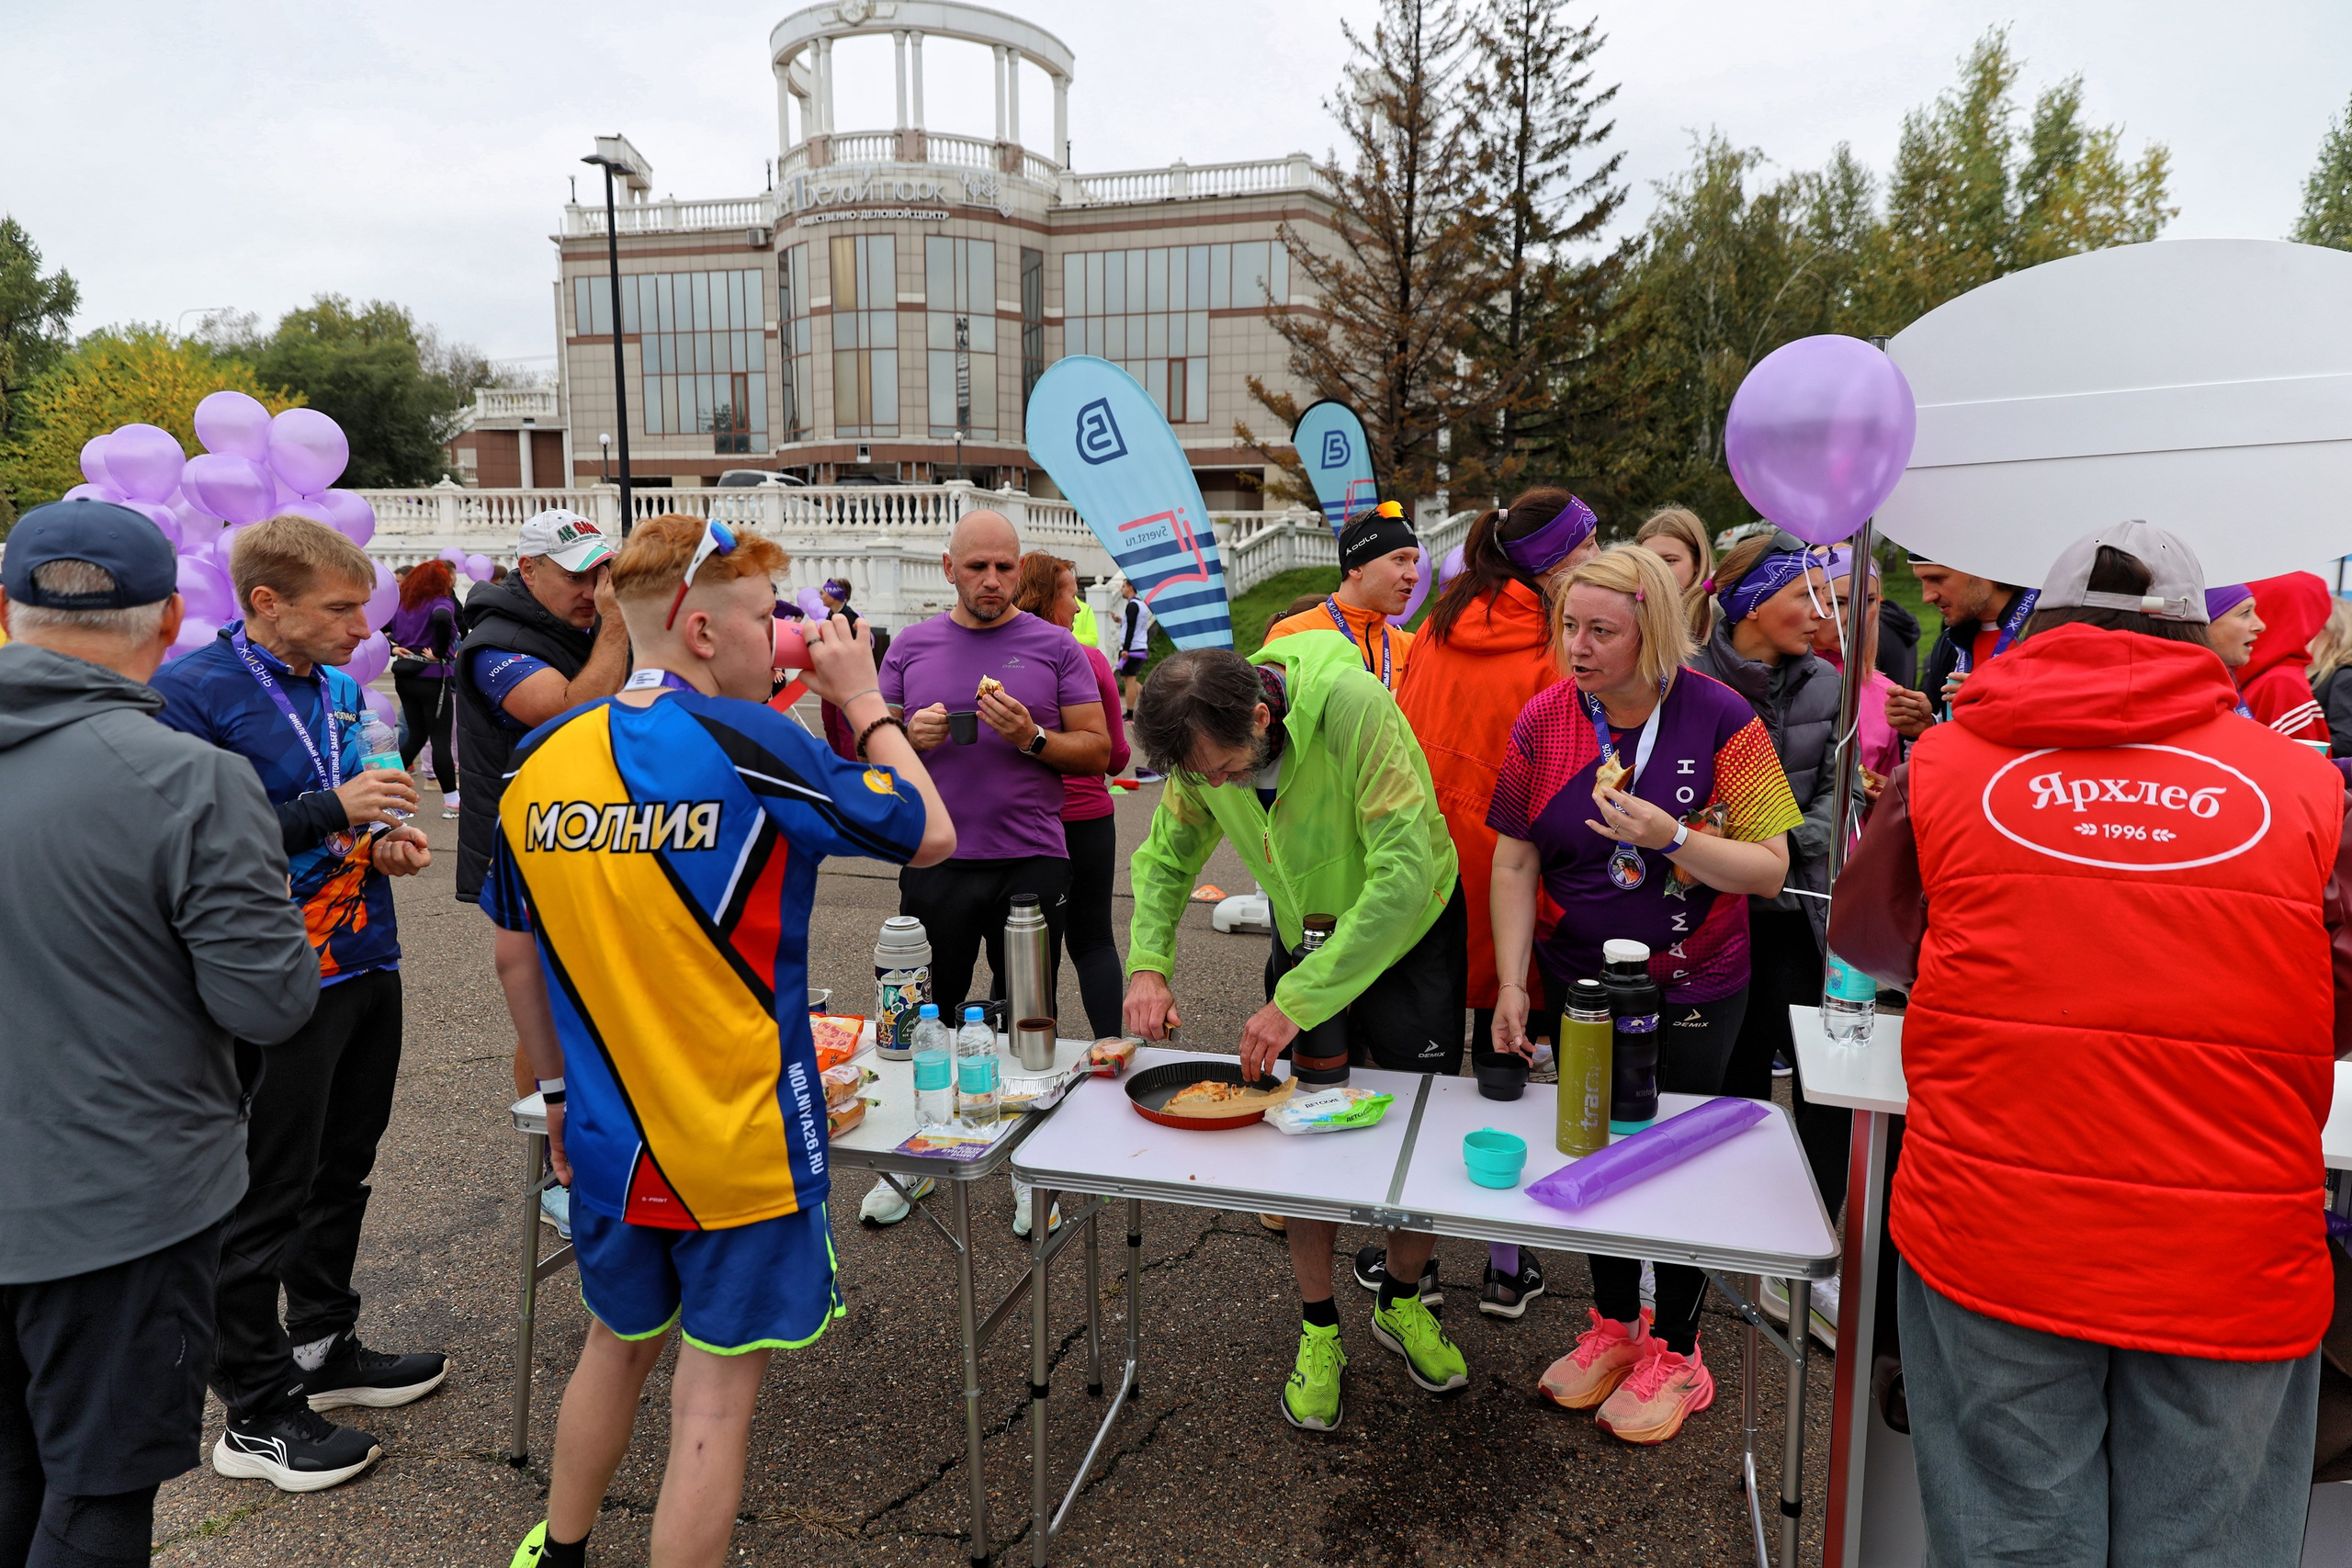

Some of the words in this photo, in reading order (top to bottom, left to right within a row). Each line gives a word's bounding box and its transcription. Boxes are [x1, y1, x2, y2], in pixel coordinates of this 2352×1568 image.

[1326, 602, 1345, 628] ЖИЗНЬ
[2006, 592, 2036, 632] ЖИЗНЬ
[237, 643, 274, 688] ЖИЗНЬ
[326, 712, 335, 730] 2026
[331, 730, 339, 750] ЗАБЕГ
[288, 713, 319, 758] ФИОЛЕТОВЫЙ
[313, 757, 327, 777] ЗАБЕГ
[332, 750, 341, 788] ОЛЕТОВЫЙ
[2028, 771, 2228, 818] Ярхлеб
[525, 799, 724, 853] МОЛНИЯ
[2102, 824, 2148, 840] 1996
[787, 1062, 825, 1176] MOLNIYA26.RU
[1305, 1098, 1340, 1109] ДЕТСКИЕ
